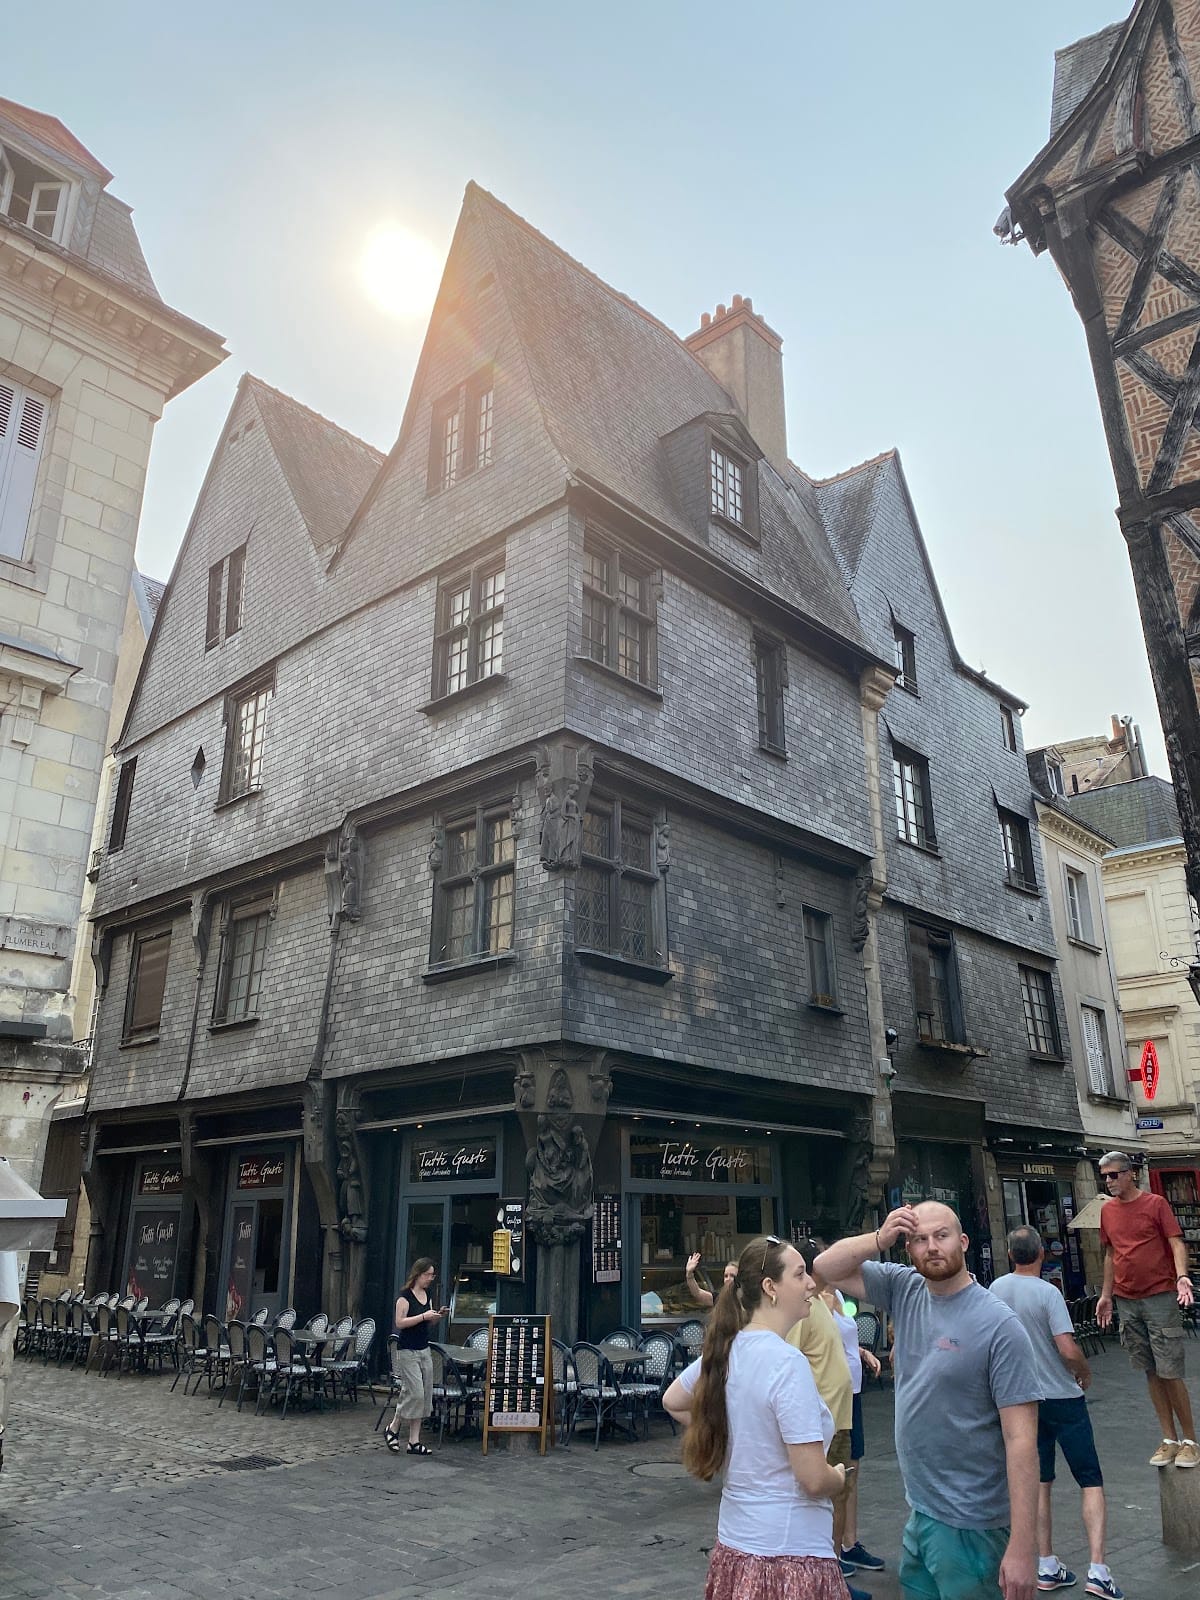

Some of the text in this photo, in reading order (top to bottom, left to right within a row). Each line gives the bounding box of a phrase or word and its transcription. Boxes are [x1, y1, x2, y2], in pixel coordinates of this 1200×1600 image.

[19, 926, 46, 937] PLACE
[4, 936, 58, 950] PLUMEREAU
[240, 1162, 258, 1177] Tutti
[260, 1160, 284, 1183] Gusti
[419, 1147, 488, 1175] Tutti Gusti
[659, 1142, 752, 1180] Tutti Gusti
[143, 1171, 160, 1184] Tutti
[160, 1170, 182, 1190] Gusti
